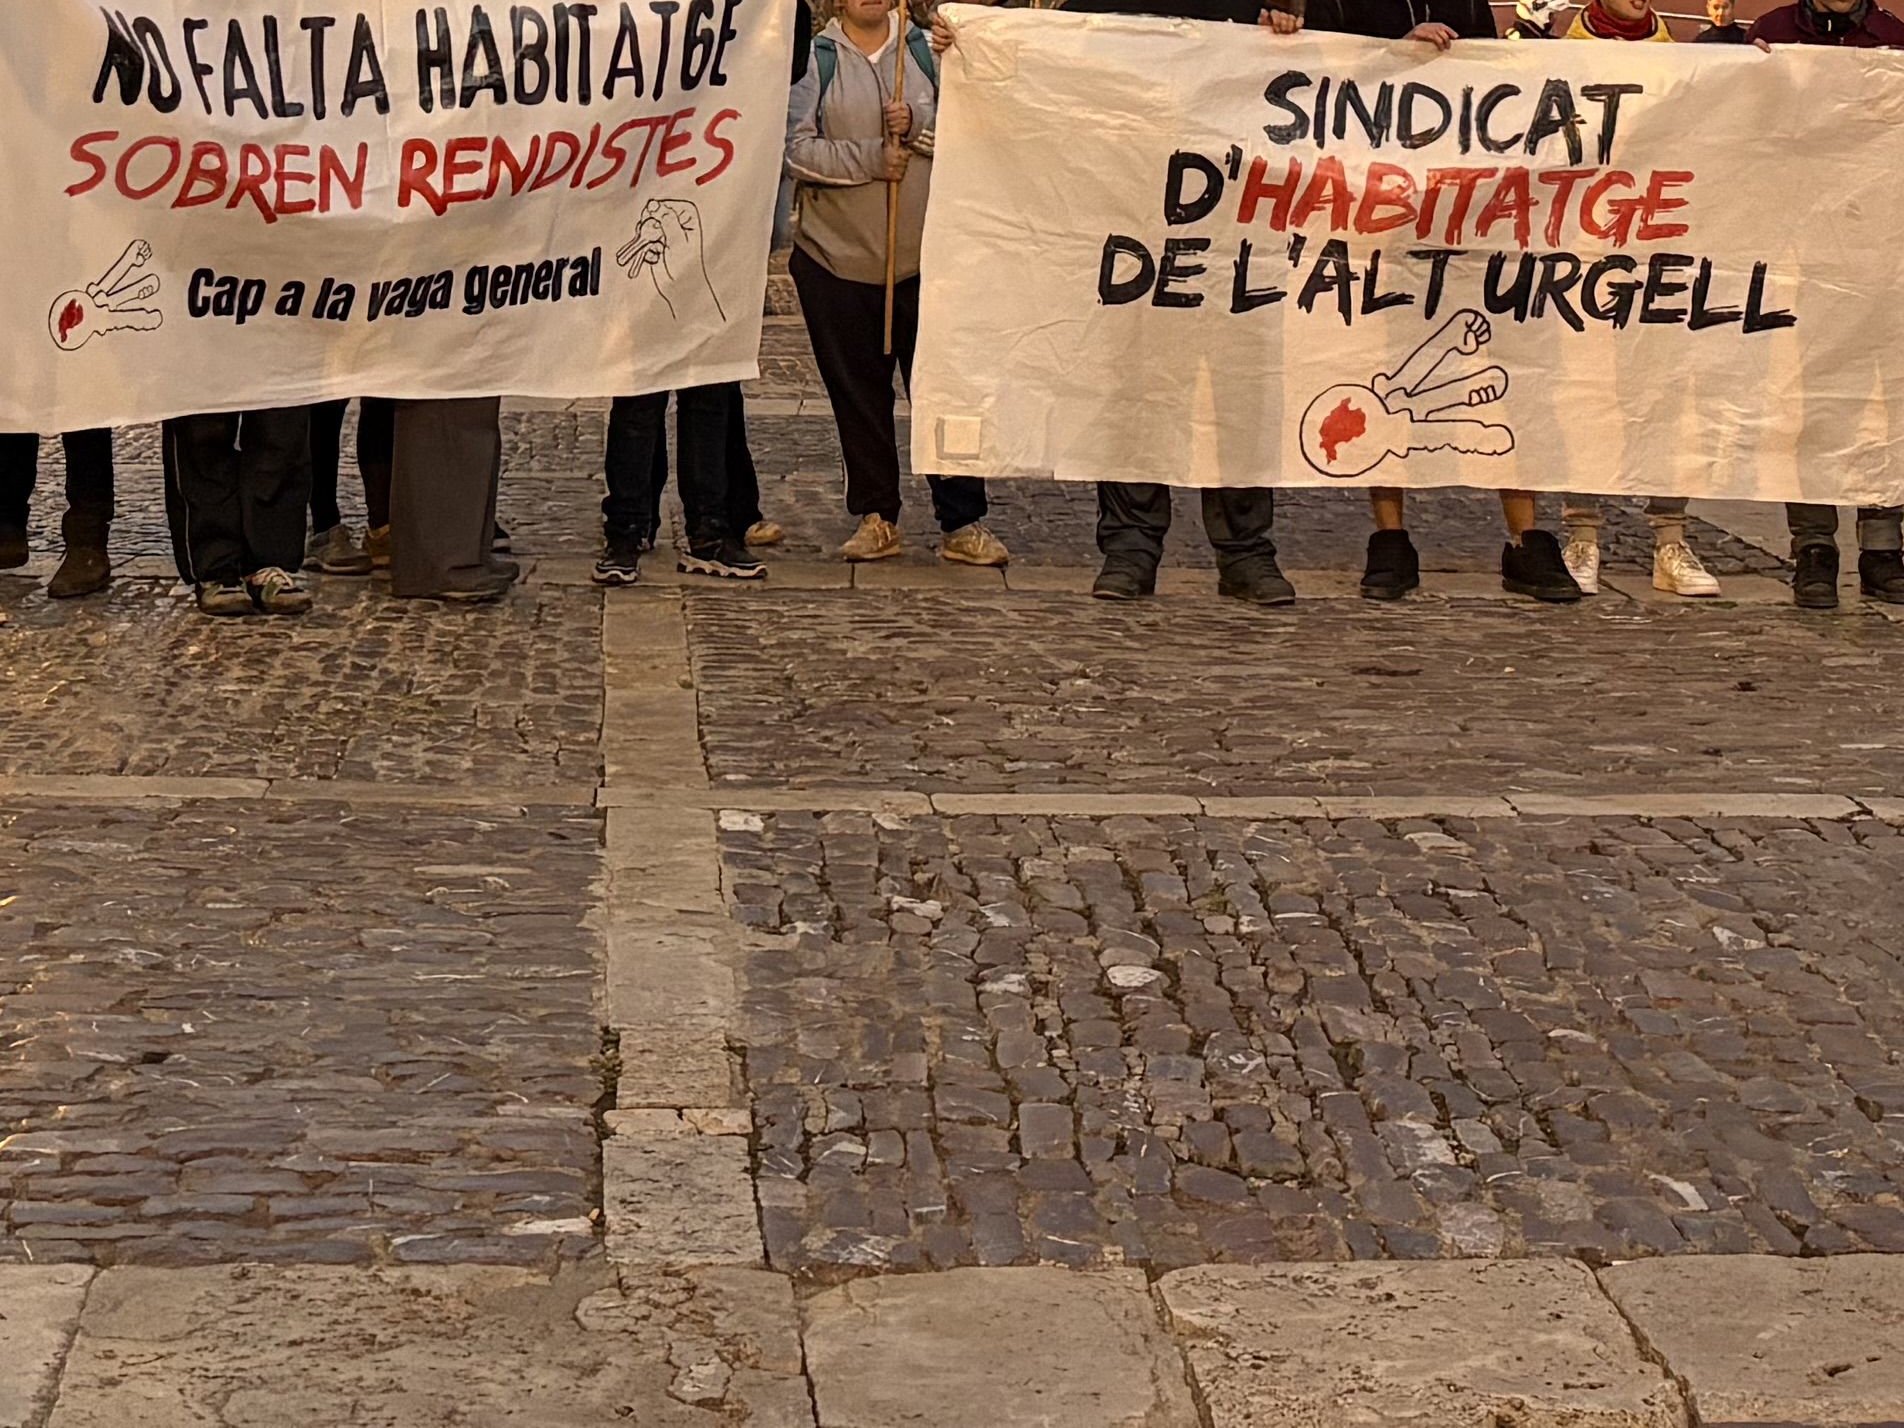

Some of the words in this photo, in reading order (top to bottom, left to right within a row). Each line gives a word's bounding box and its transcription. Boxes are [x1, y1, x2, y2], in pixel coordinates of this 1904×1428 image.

[93, 6, 181, 113] NO
[183, 14, 389, 120] FALTA
[64, 133, 367, 223] SOBREN
[400, 108, 741, 214] RENDISTES
[1264, 71, 1643, 166] SINDICAT
[1161, 145, 1693, 249] D'HABITATGE
[188, 268, 266, 324] Cap
[275, 281, 305, 316] a
[312, 278, 355, 321] la
[367, 270, 453, 321] vaga
[462, 247, 601, 315] general
[1098, 234, 1211, 308] DE
[1230, 233, 1468, 326] L'ALT
[1484, 251, 1797, 333] URGELL
